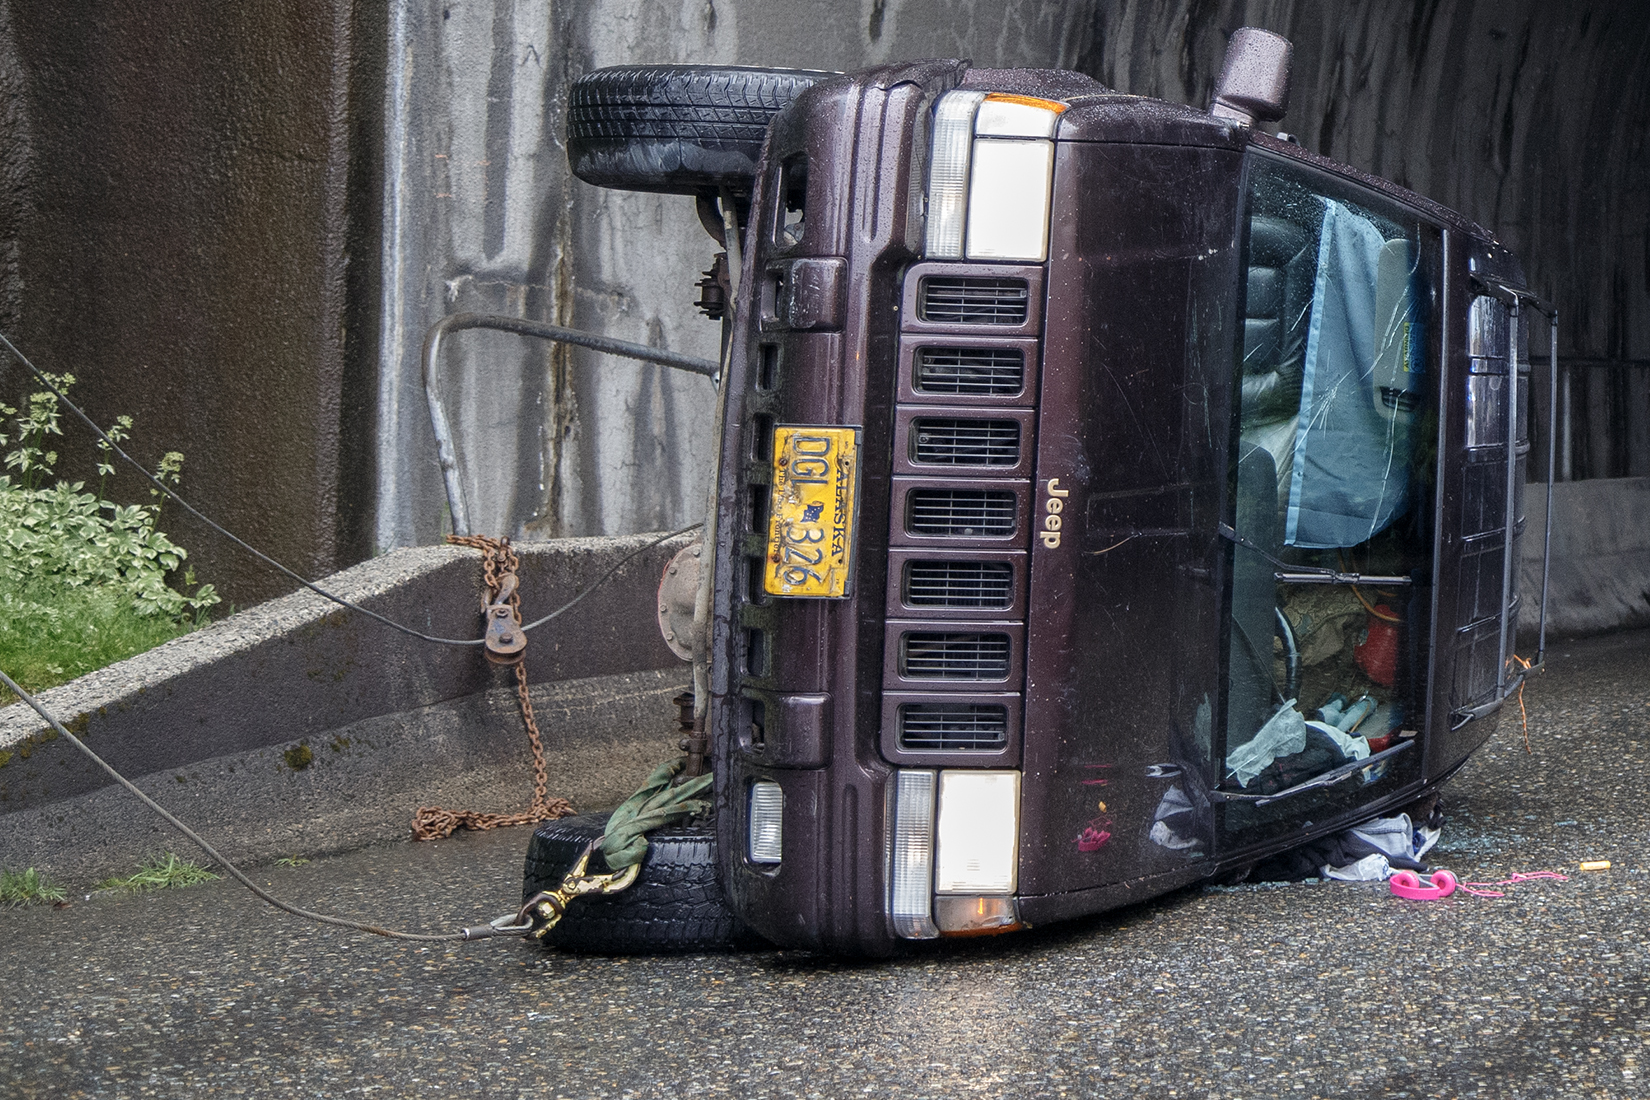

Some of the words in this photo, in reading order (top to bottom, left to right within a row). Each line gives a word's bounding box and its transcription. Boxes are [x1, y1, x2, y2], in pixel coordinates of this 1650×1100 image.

[791, 437, 831, 497] DGL
[831, 469, 848, 557] ALASKA
[1040, 478, 1069, 549] Jeep
[783, 526, 825, 586] 326
